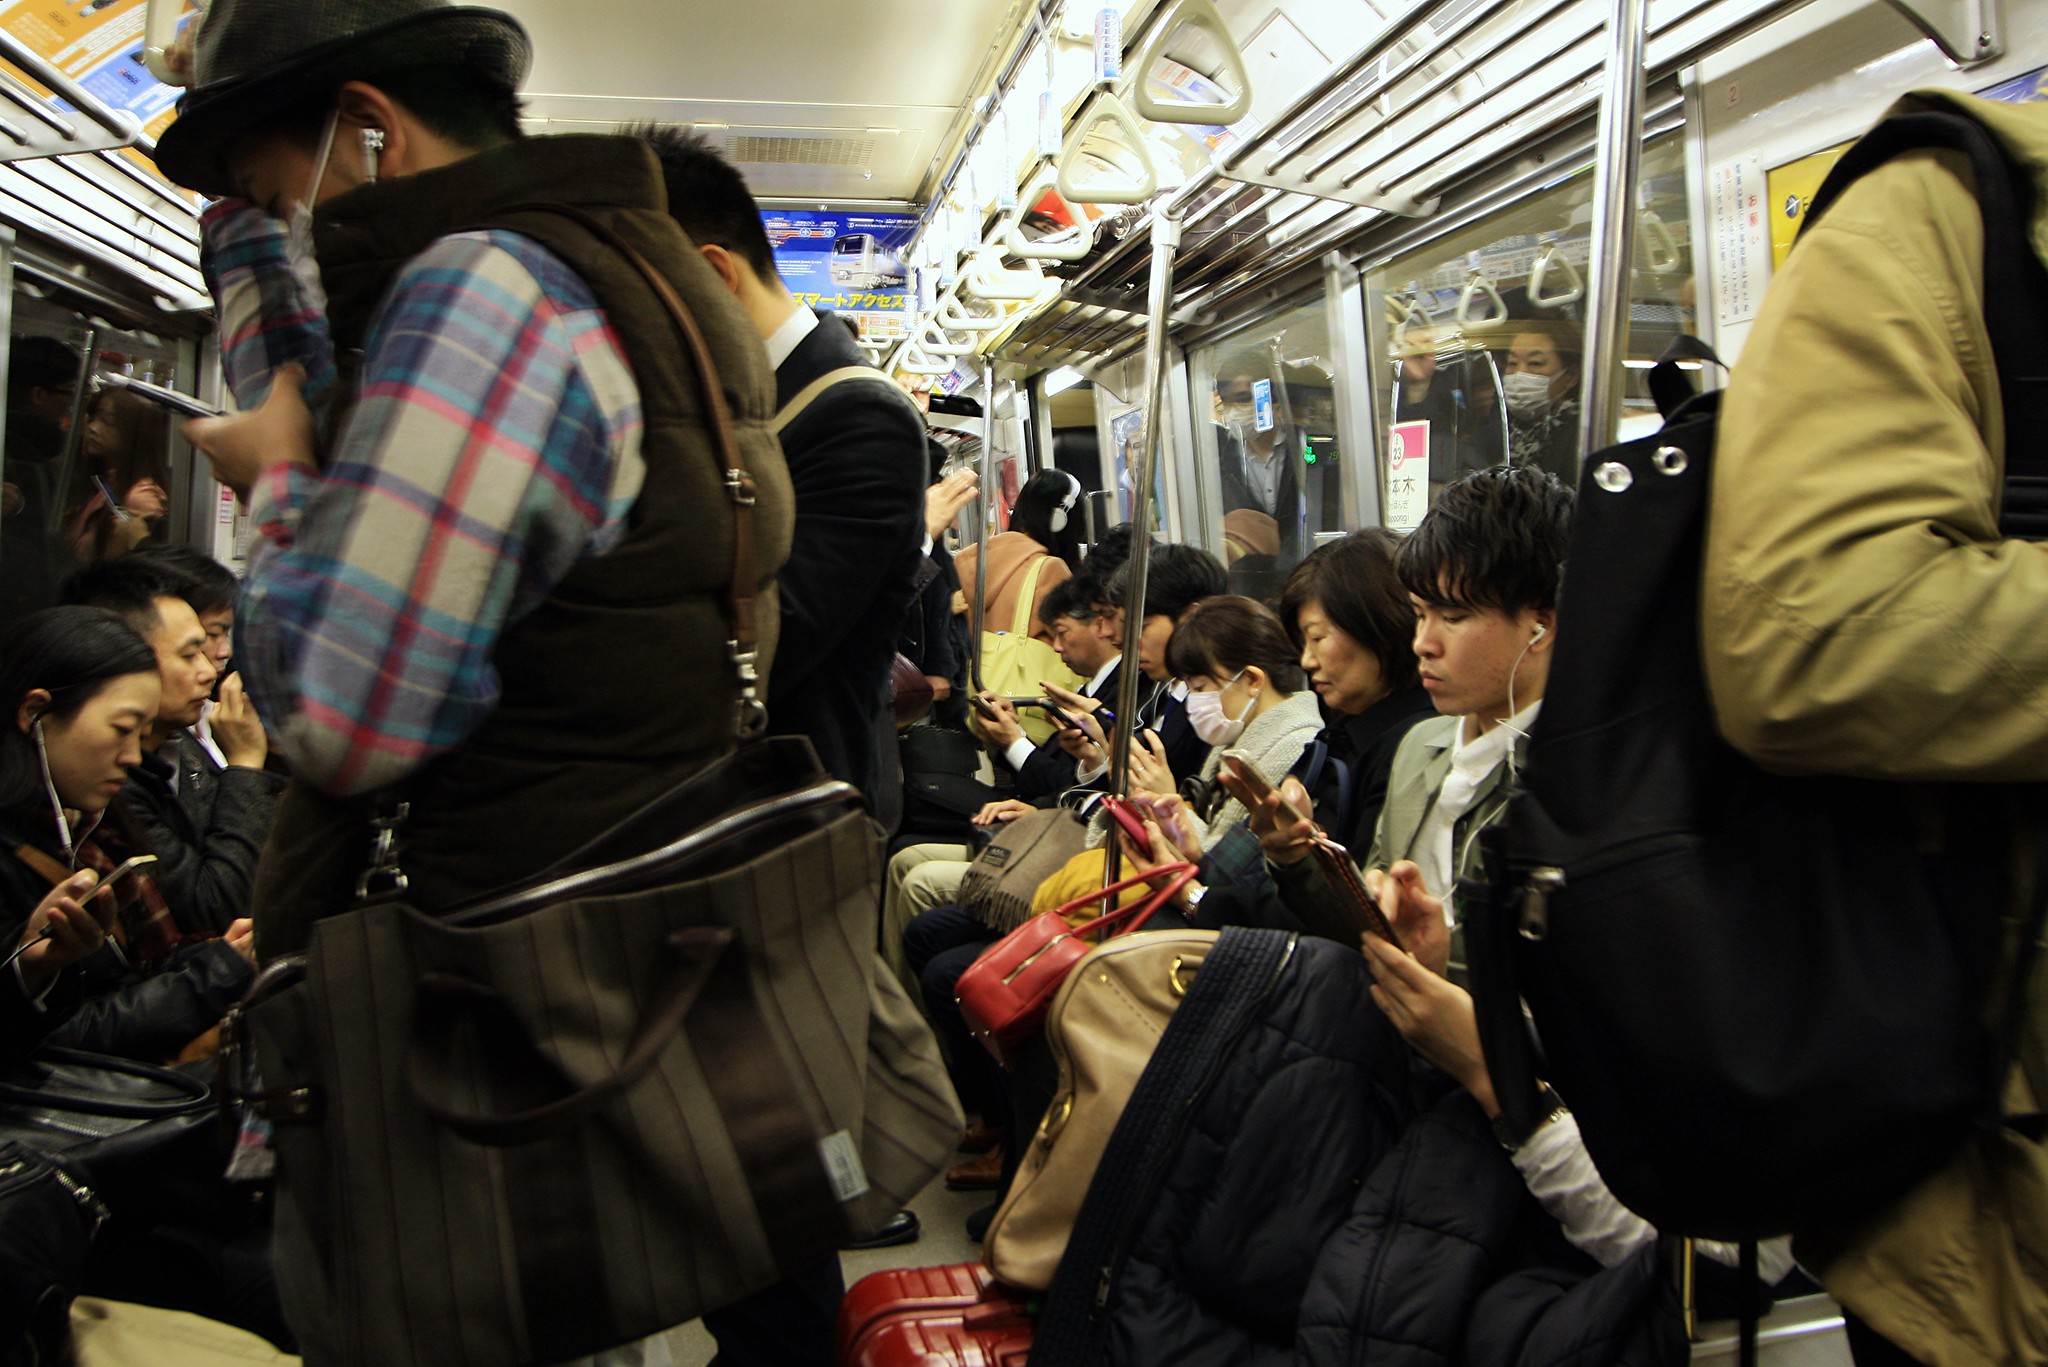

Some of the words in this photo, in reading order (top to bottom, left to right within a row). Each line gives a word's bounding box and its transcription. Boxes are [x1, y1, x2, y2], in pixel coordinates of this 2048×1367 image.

[793, 292, 906, 309] スマートアクセス
[1392, 447, 1402, 460] 23
